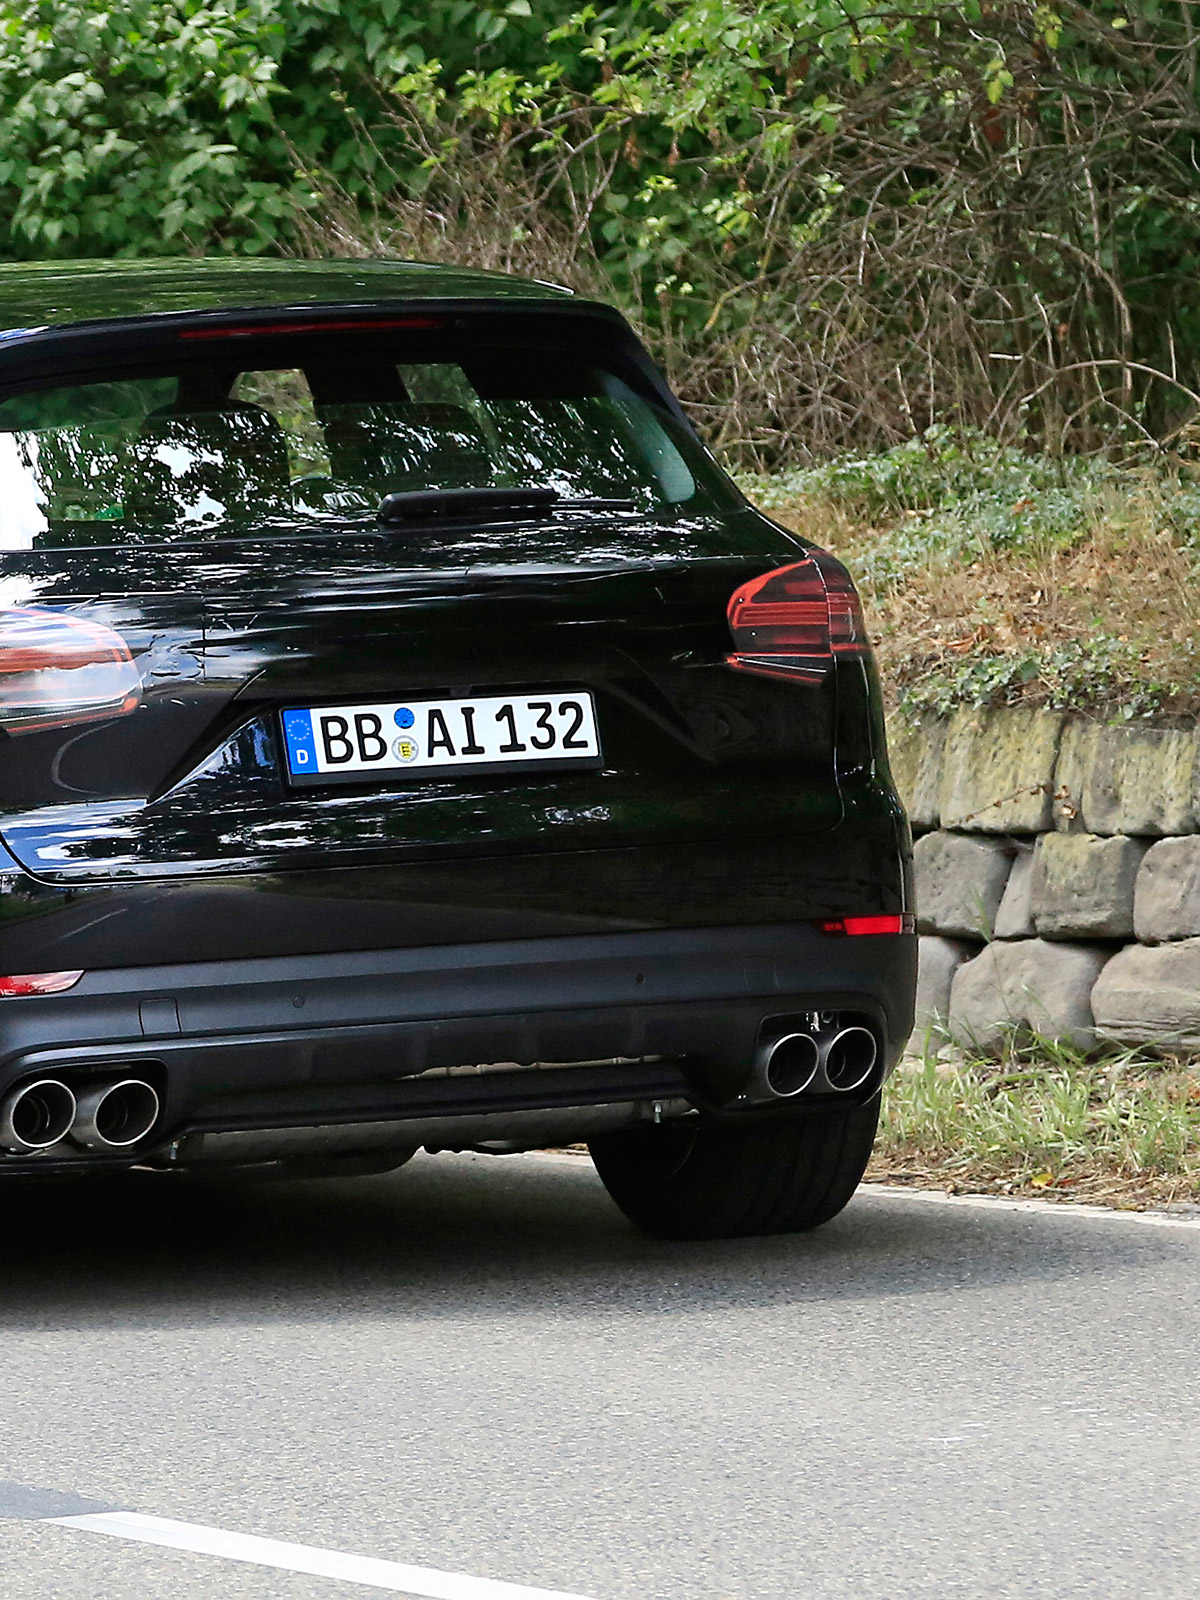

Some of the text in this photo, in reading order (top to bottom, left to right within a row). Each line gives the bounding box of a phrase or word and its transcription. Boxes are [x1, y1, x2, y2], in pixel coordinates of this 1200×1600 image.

[320, 701, 588, 764] BB AI 132
[296, 749, 308, 764] D
